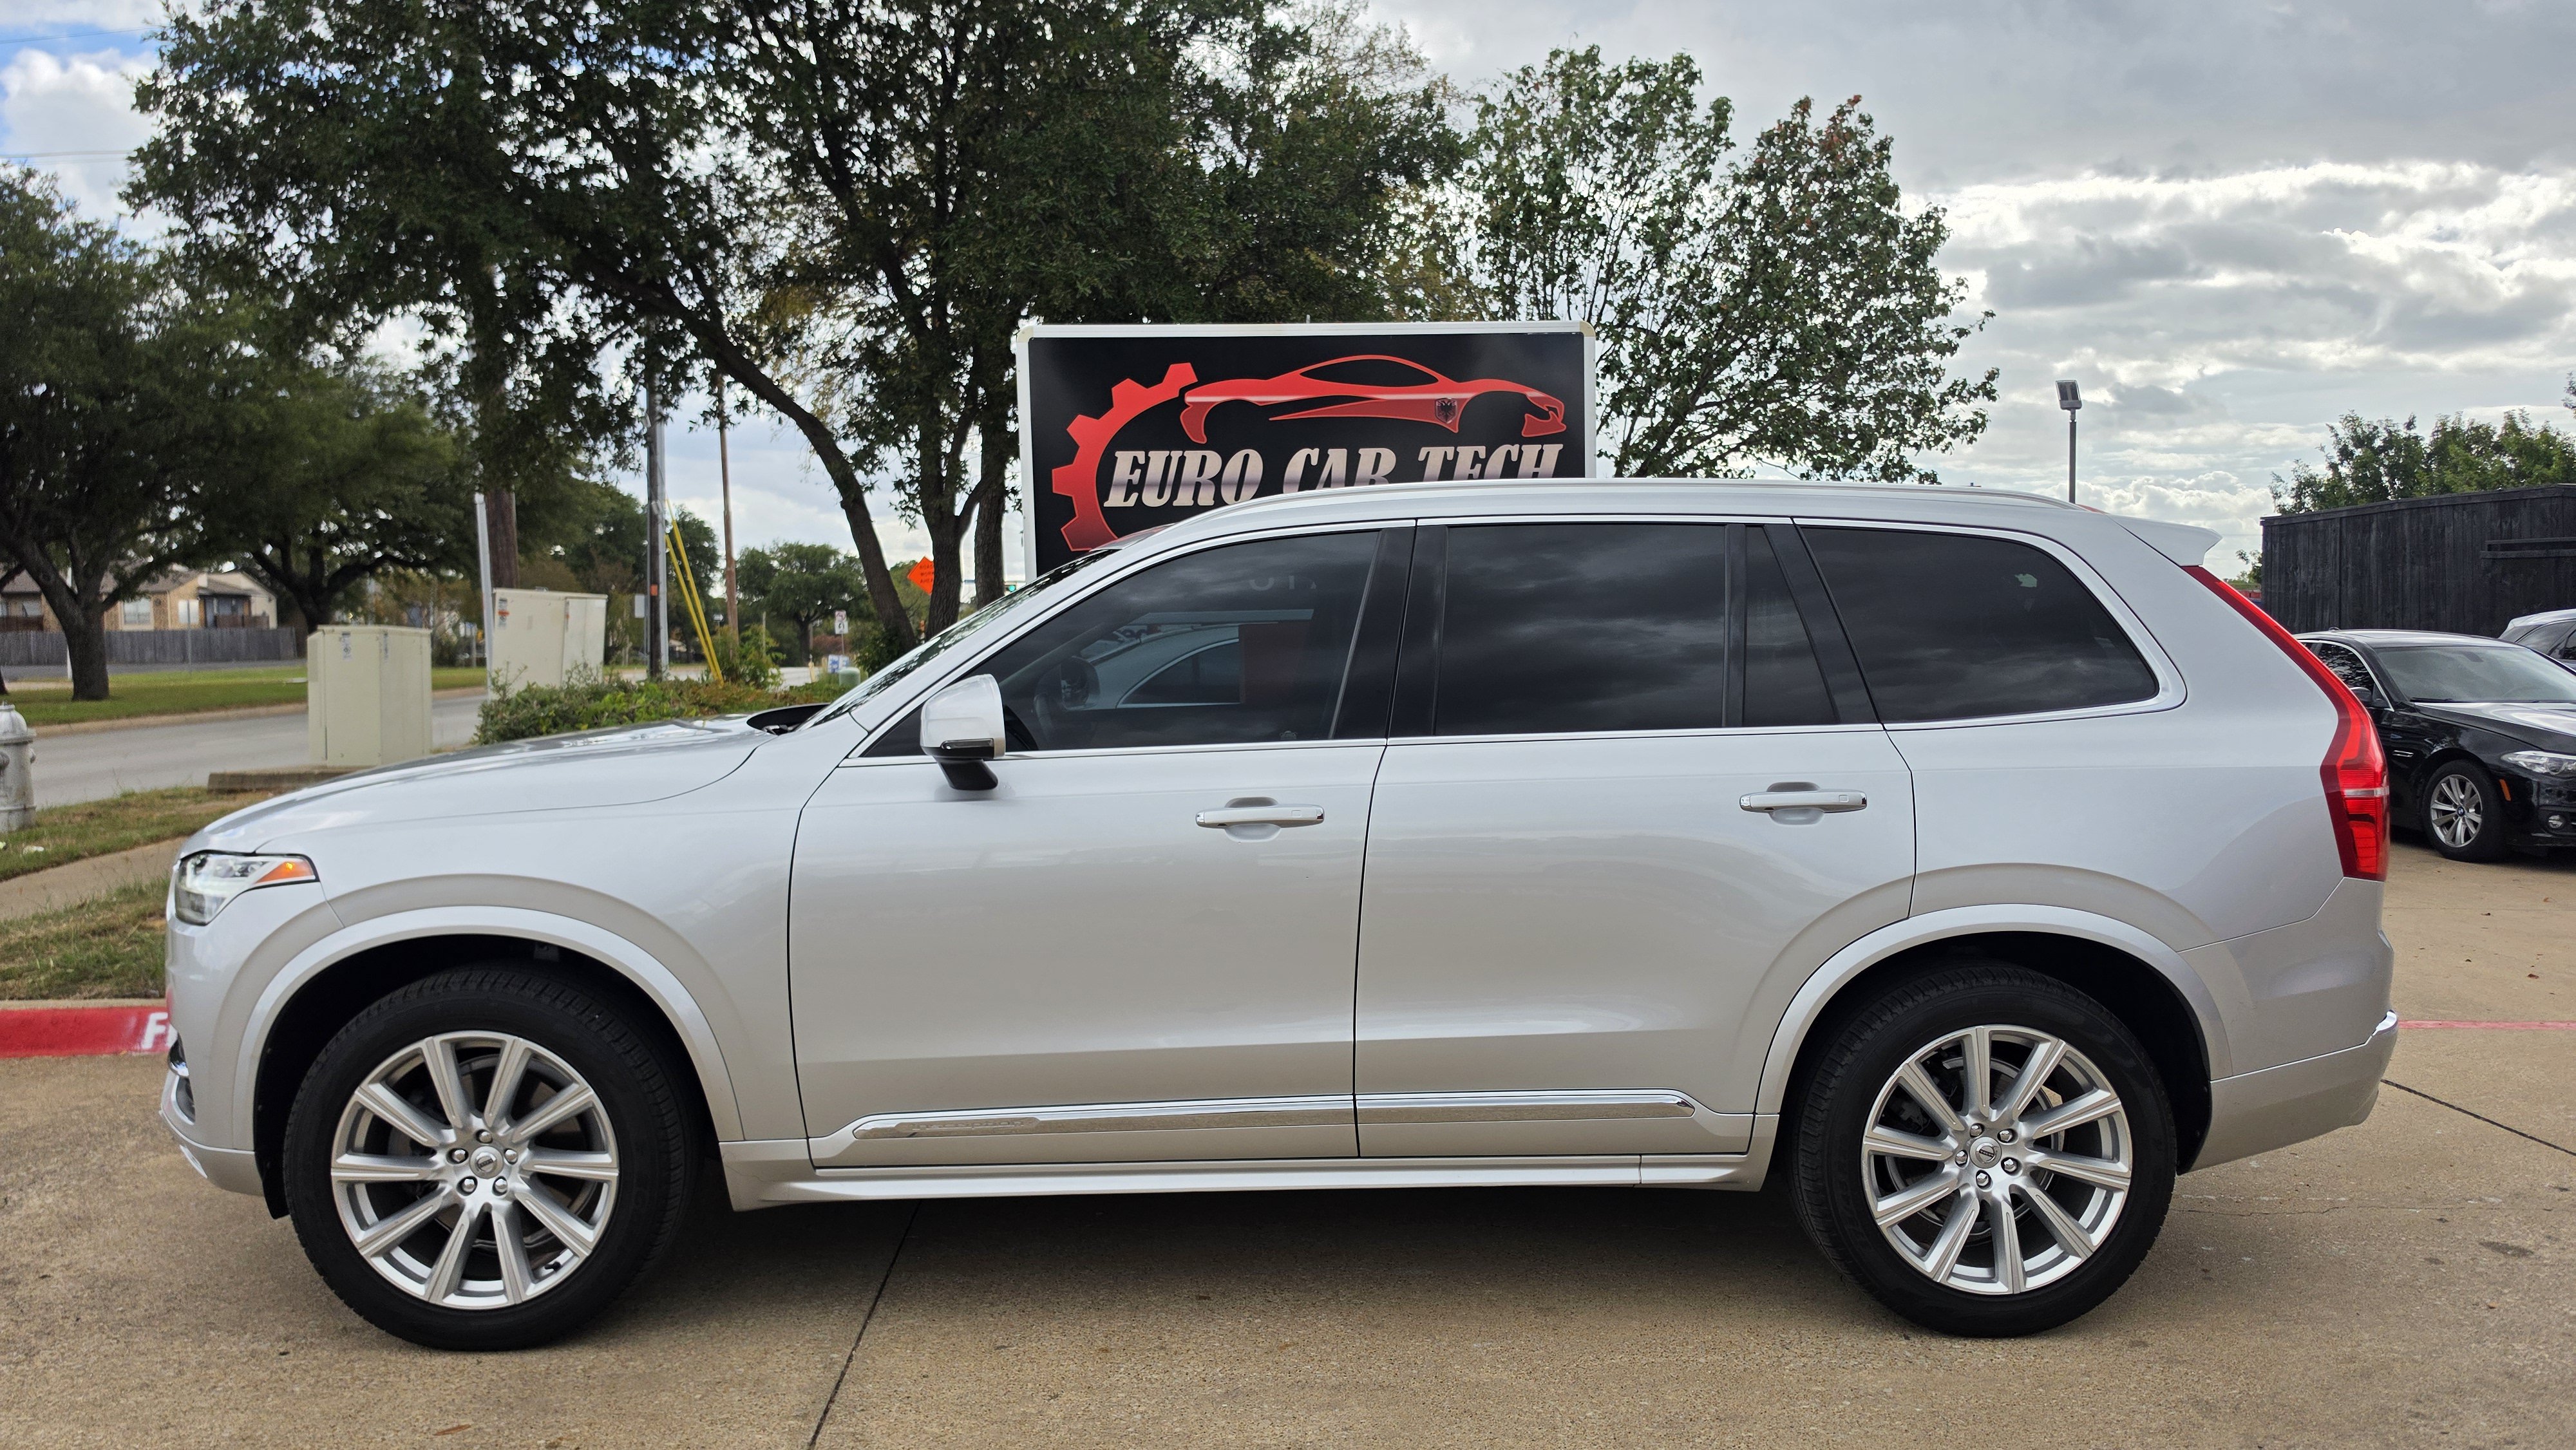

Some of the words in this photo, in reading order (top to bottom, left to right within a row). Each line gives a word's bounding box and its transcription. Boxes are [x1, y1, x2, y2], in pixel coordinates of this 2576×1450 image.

[1103, 449, 1263, 507] EURO
[1283, 447, 1396, 494] CAR
[1418, 444, 1563, 482] TECH
